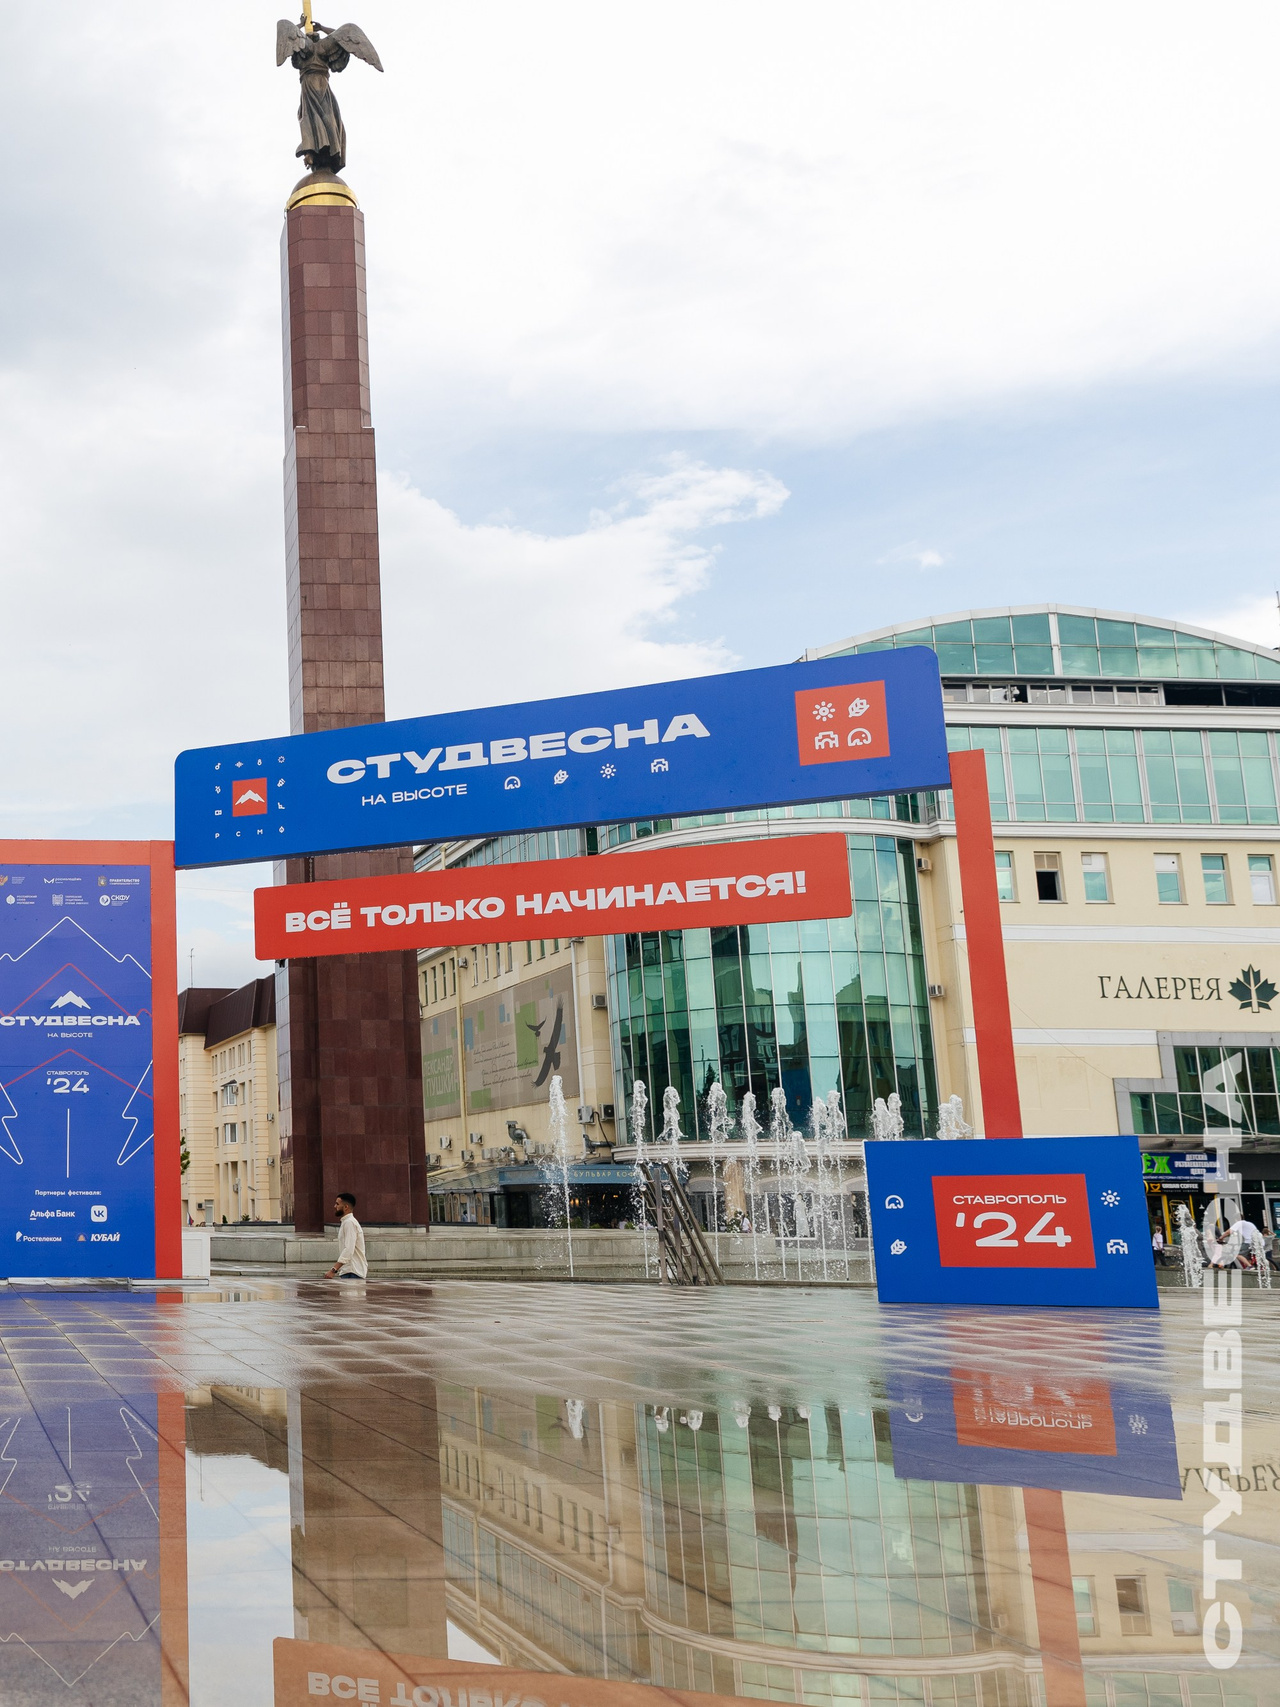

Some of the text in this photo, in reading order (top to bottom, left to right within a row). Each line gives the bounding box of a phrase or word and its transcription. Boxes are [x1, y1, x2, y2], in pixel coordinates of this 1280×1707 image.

[326, 713, 710, 785] СТУДВЕСНА
[361, 783, 468, 807] НА ВЫСОТЕ
[285, 870, 807, 933] ВСЁ ТОЛЬКО НАЧИНАЕТСЯ!
[1098, 975, 1224, 1001] ГАЛЕРЕЯ
[0, 1015, 141, 1027] СТУДВЕСНА
[423, 1055, 454, 1076] ЛЕКСАНДР
[46, 1077, 90, 1094] '24
[574, 1170, 612, 1178] БУЛЬВАР
[67, 1189, 102, 1197] фестиваля:
[952, 1194, 1068, 1206] СТАВРОПОЛЬ
[29, 1209, 76, 1221] Альфа Банк
[90, 1231, 121, 1242] КУБАЙ
[955, 1211, 1072, 1248] '24
